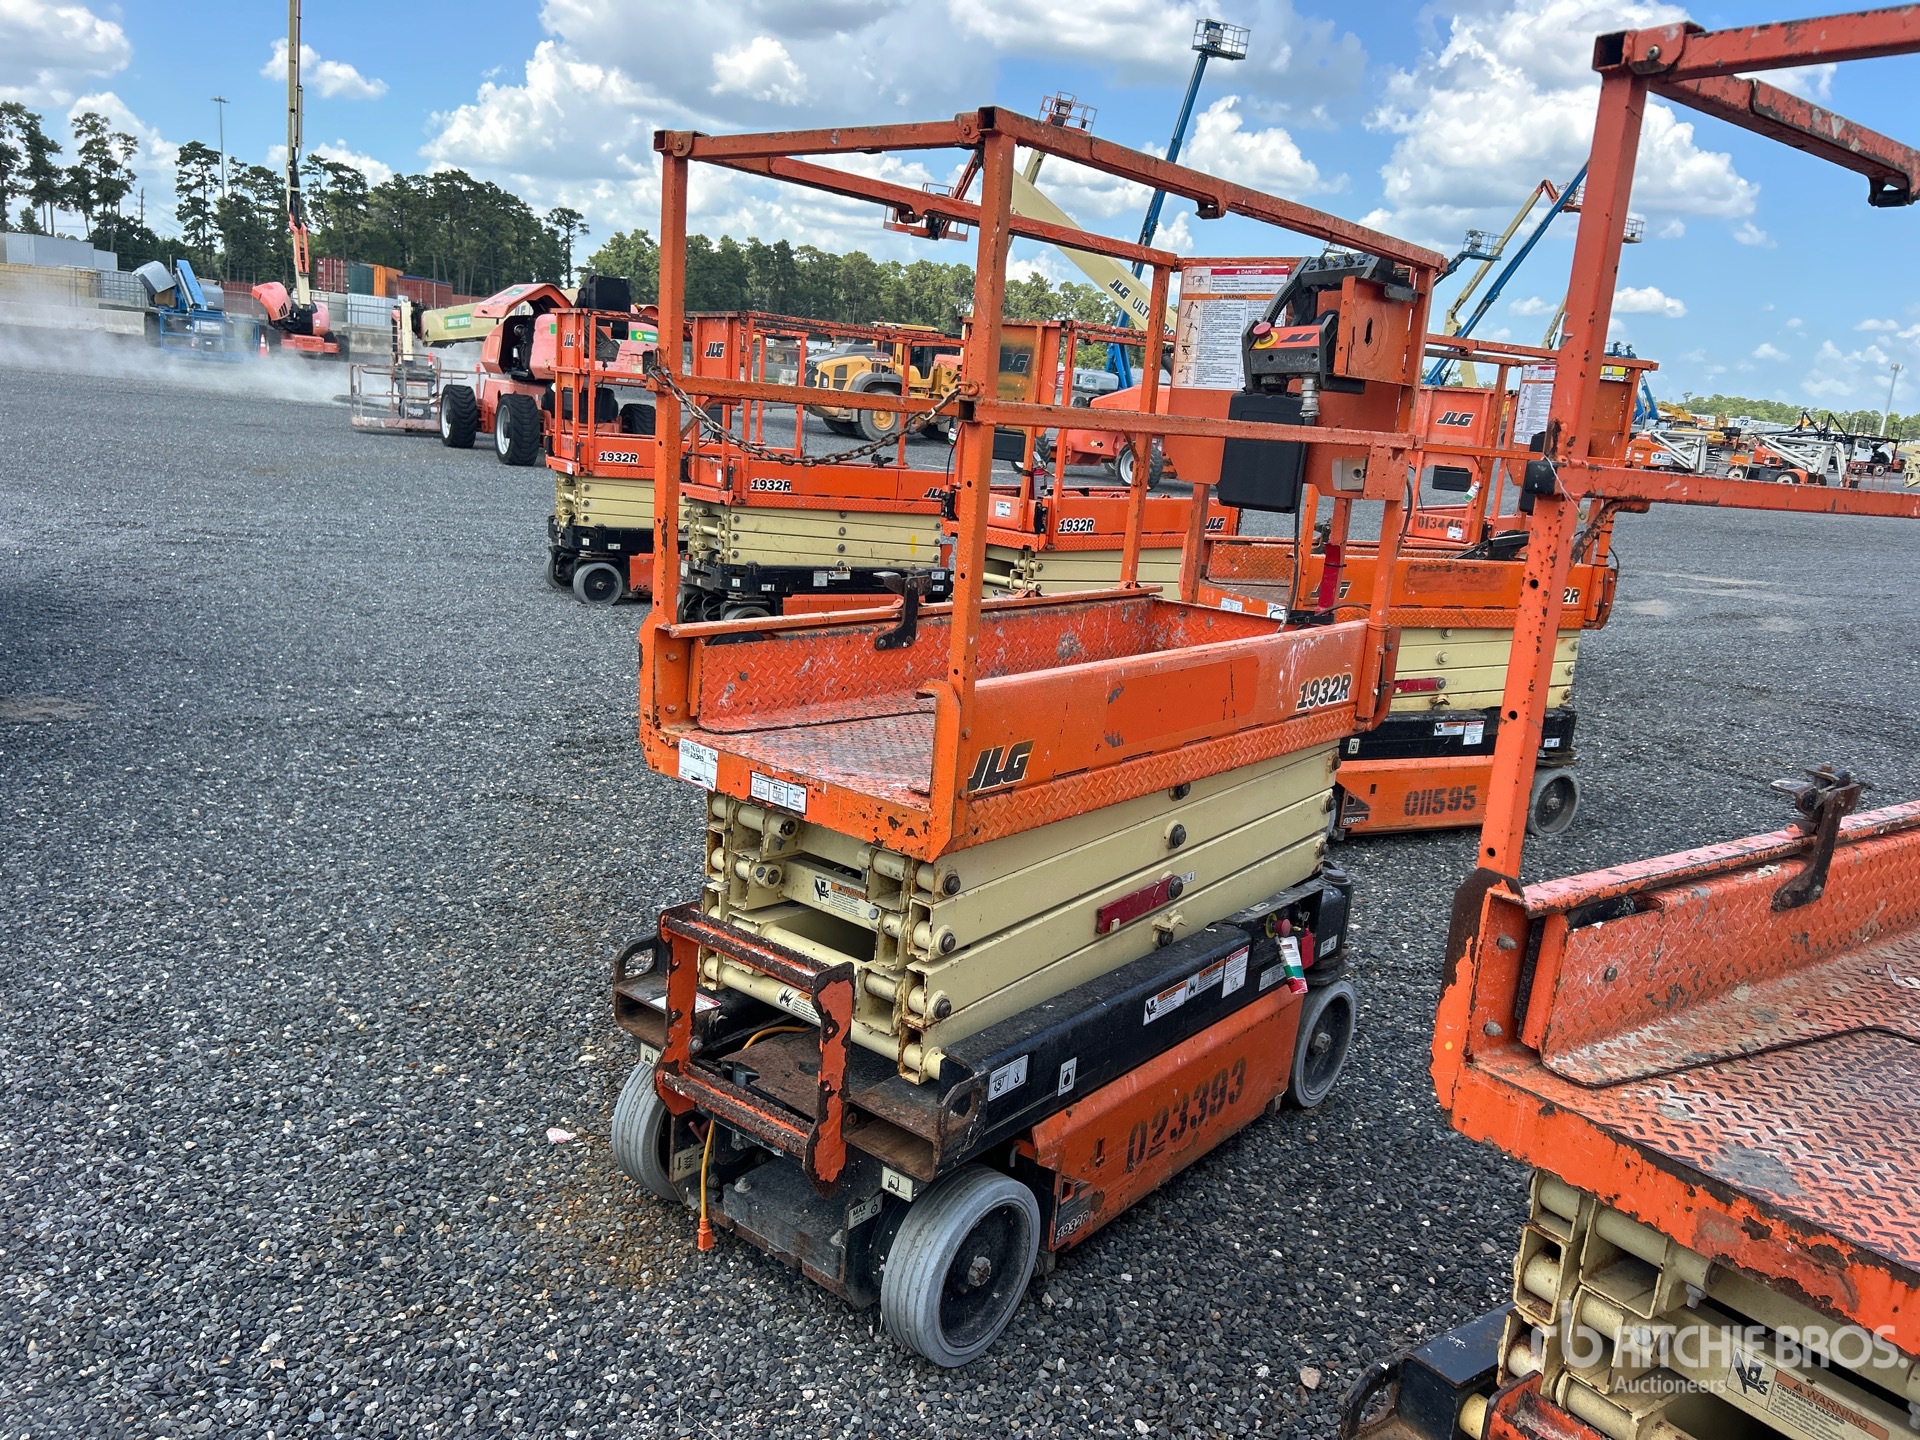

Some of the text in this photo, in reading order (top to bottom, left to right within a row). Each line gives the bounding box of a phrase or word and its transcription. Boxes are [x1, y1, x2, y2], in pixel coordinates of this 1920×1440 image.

[1108, 279, 1132, 300] JLG
[1132, 297, 1151, 321] ULT
[705, 342, 725, 358] JLG
[1001, 353, 1031, 374] LG
[1436, 411, 1476, 428] JLG
[599, 451, 639, 464] 1932R
[751, 478, 792, 492] 1932R
[1058, 517, 1095, 533] 1932R
[1205, 516, 1226, 530] JLG
[1295, 672, 1353, 712] 1932R
[967, 739, 1036, 793] JLG
[1403, 784, 1478, 817] 011595
[852, 1204, 867, 1216] MAX
[1806, 1390, 1869, 1429] WARNING
